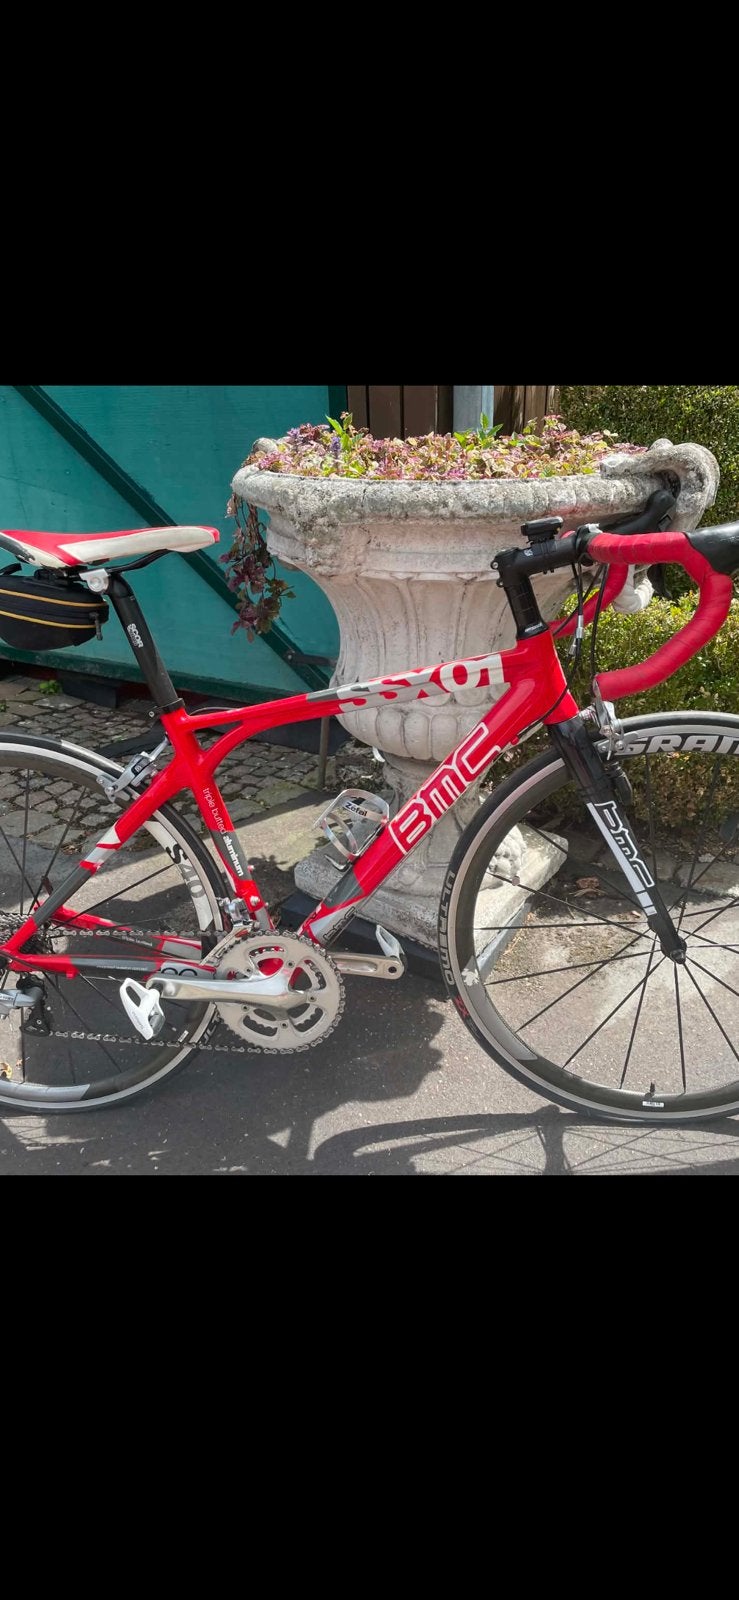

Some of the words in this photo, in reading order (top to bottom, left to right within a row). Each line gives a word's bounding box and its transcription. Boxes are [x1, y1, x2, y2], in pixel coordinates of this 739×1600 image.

[127, 623, 144, 648] SCOR
[203, 788, 216, 808] triple
[211, 807, 227, 835] butted
[222, 835, 244, 877] aluminum
[388, 721, 502, 856] BMC
